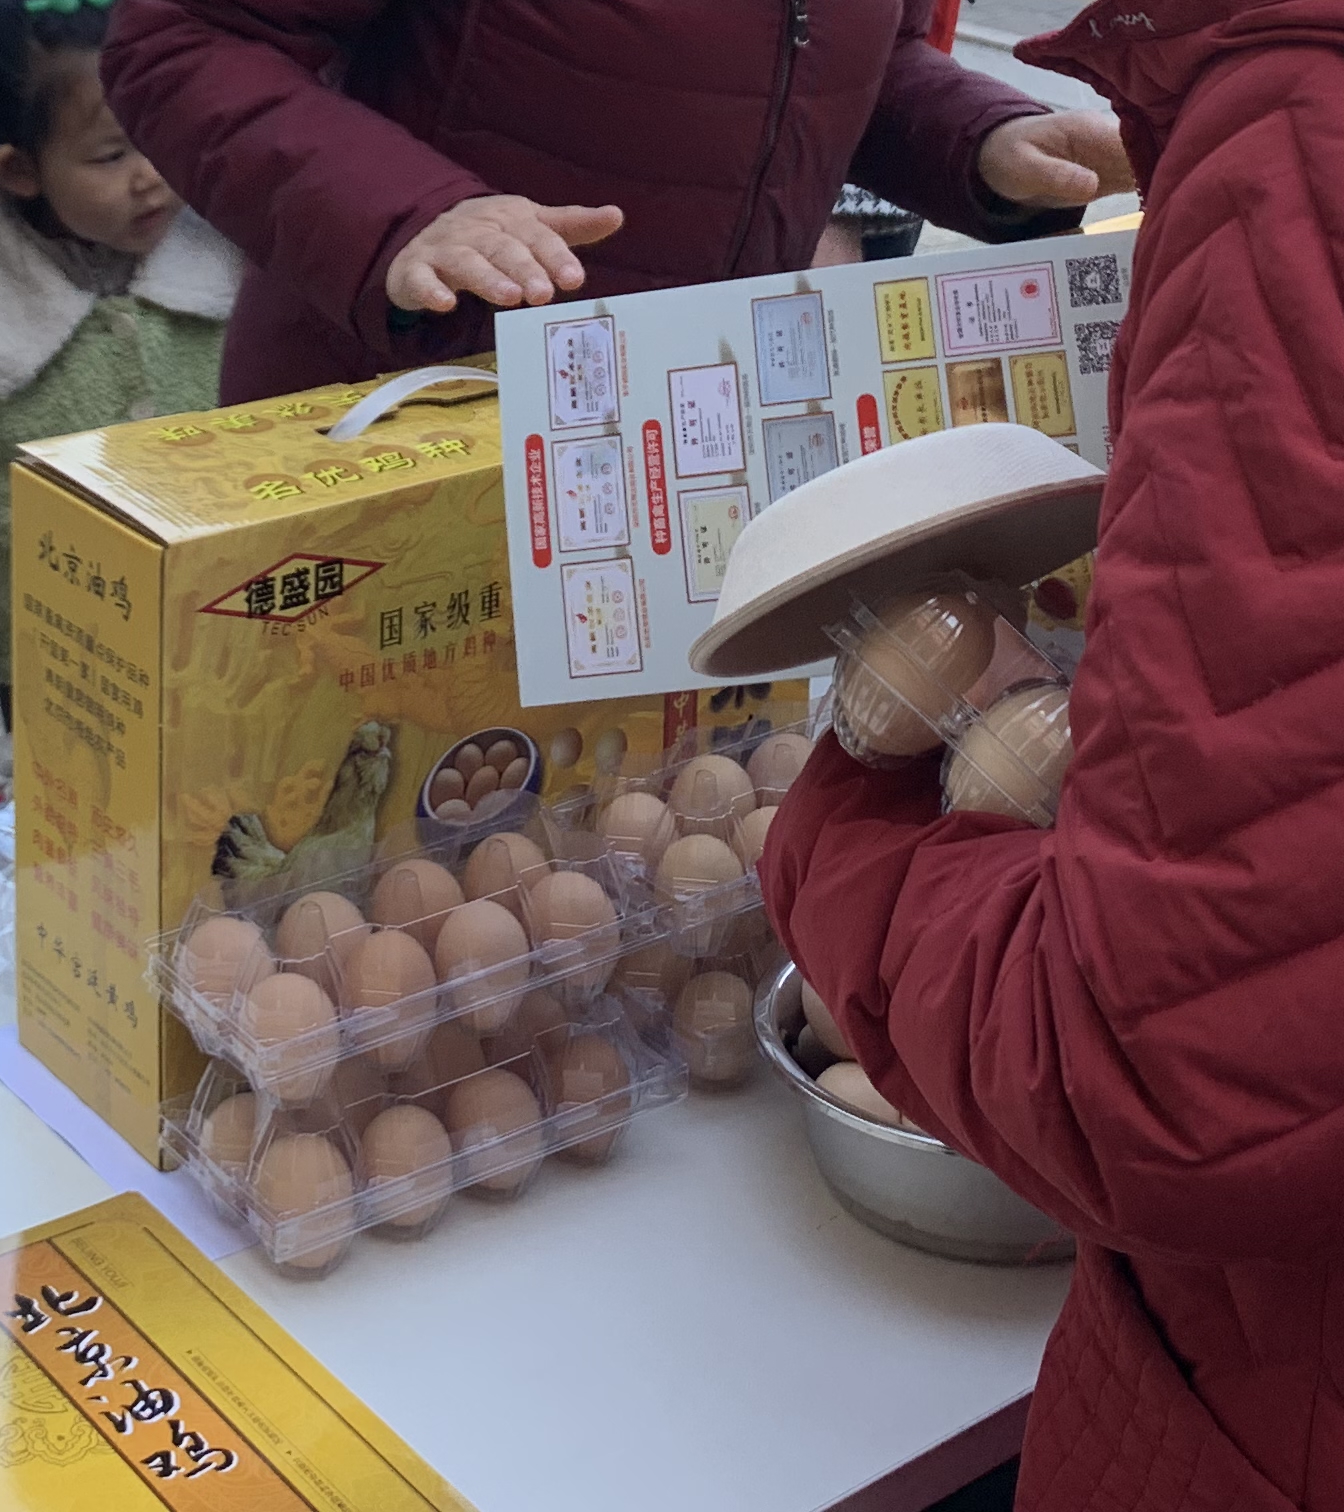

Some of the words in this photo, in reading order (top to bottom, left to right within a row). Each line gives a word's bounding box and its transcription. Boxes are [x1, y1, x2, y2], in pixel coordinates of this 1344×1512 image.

[38, 530, 133, 622] 北京油鸡
[244, 557, 344, 618] 德盛园
[380, 580, 504, 651] 国家级重
[6, 1285, 238, 1480] 北京油鸡
